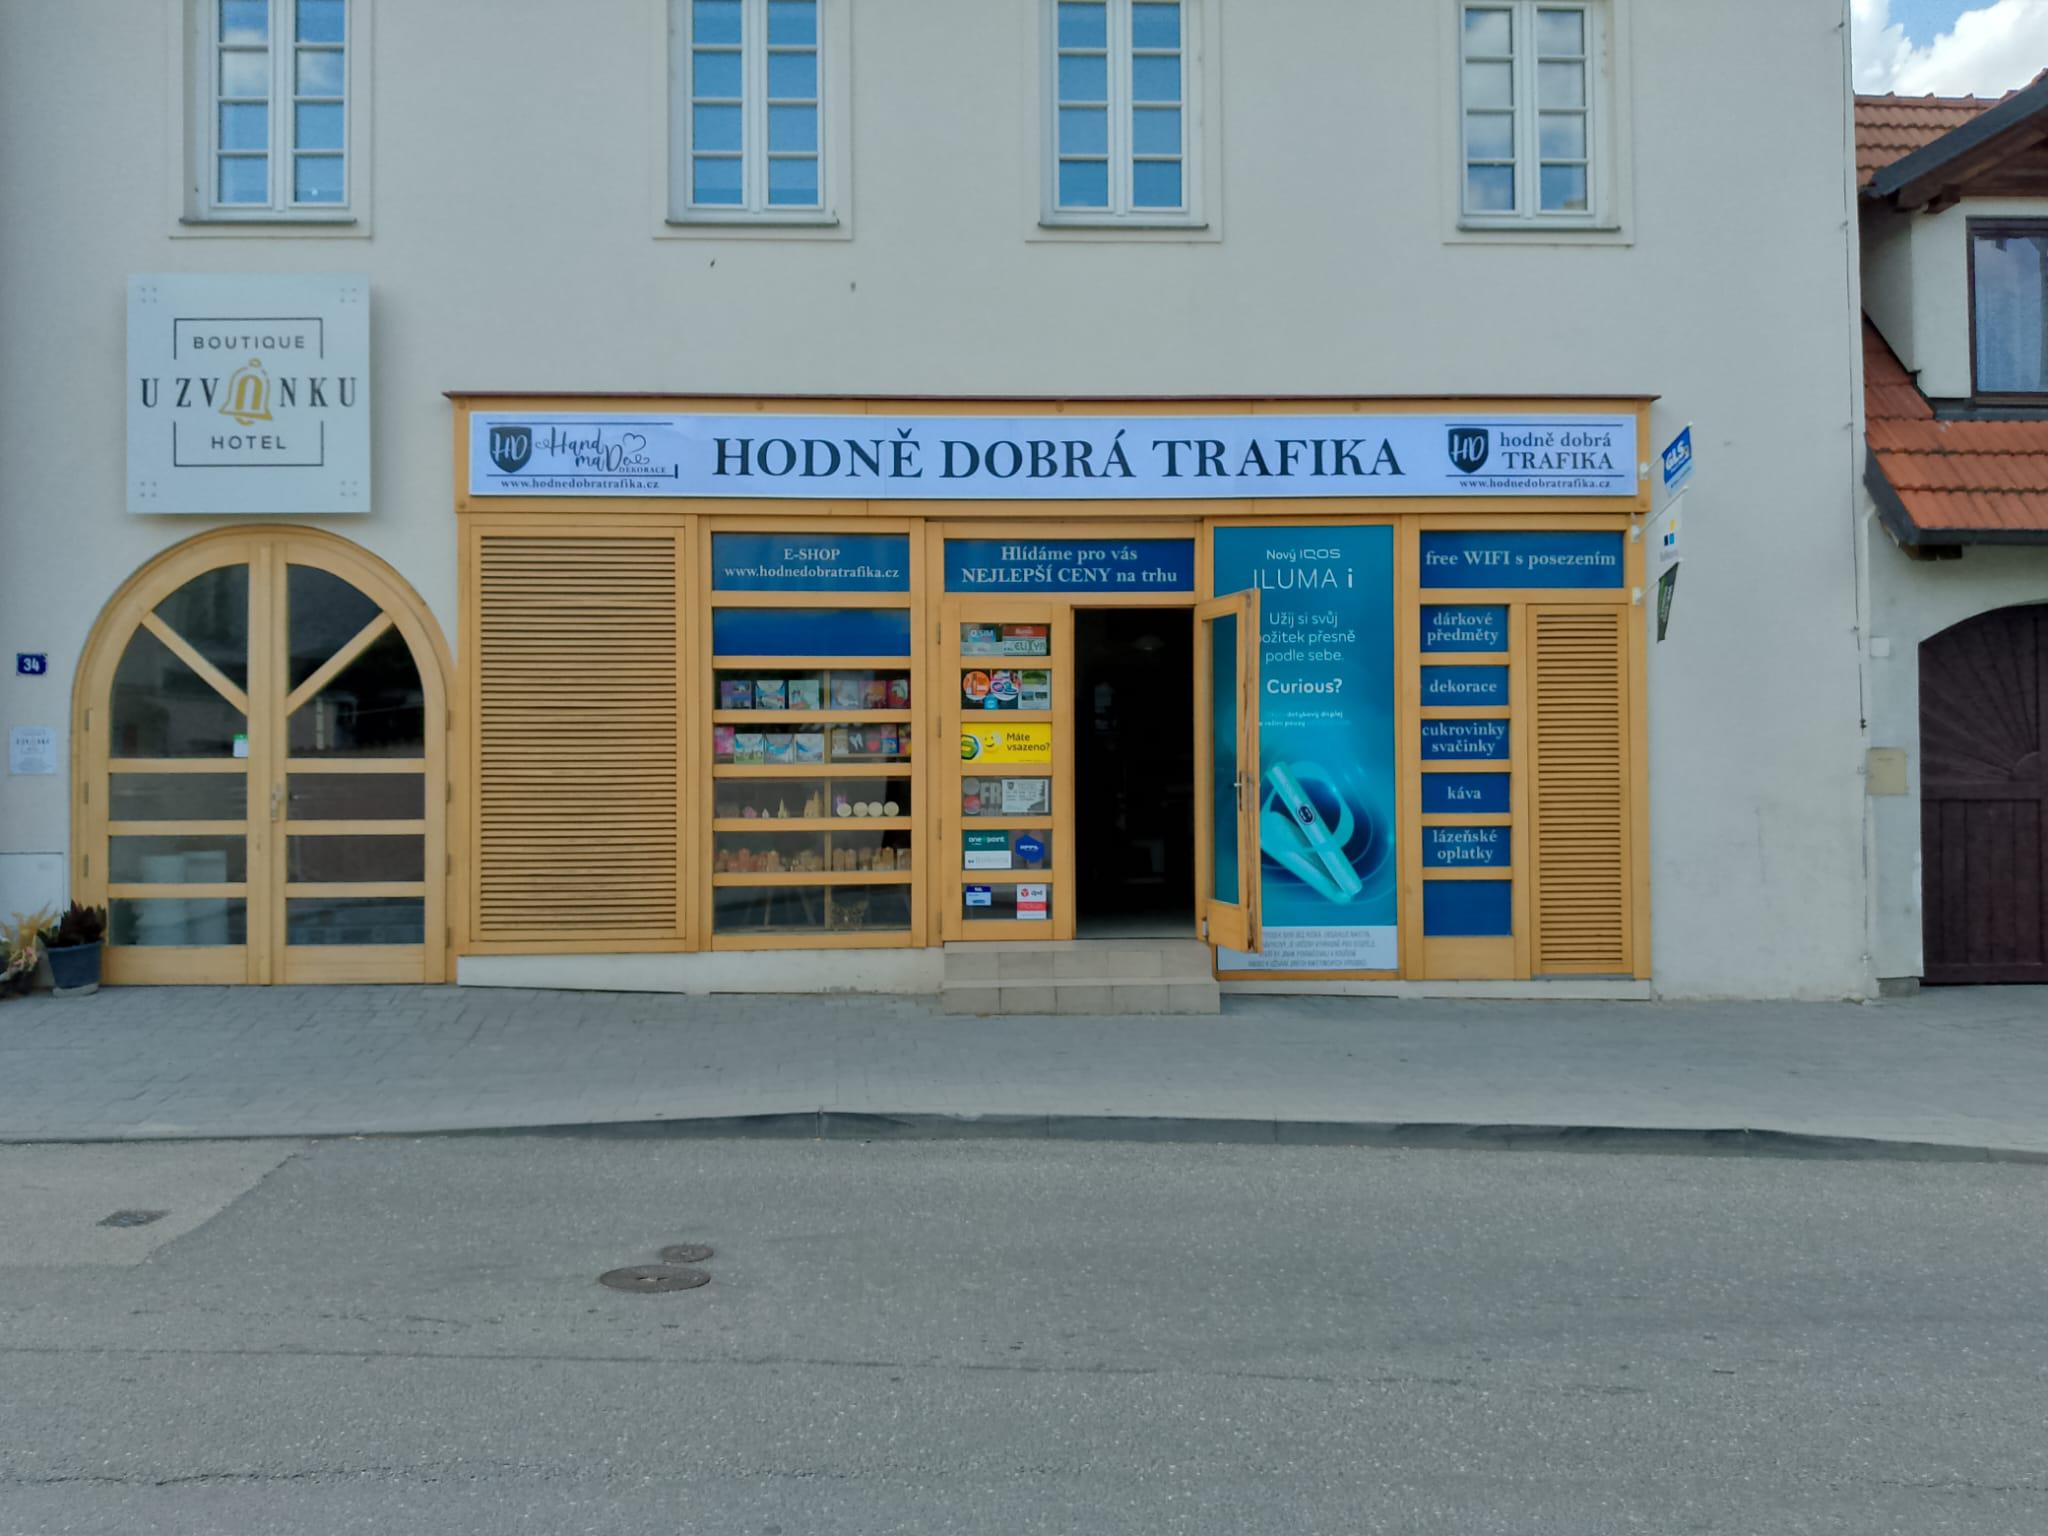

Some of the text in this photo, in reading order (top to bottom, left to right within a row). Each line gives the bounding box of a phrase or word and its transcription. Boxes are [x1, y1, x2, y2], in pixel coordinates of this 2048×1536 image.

[193, 336, 305, 350] BOUTIQUE
[211, 436, 287, 450] HOTEL
[535, 427, 605, 458] Hand
[1499, 432, 1612, 448] hodně dobrá
[712, 428, 1406, 478] HODNĚ DOBRÁ TRAFIKA
[1501, 452, 1614, 470] TRAFIKA
[500, 478, 660, 489] www.hodnedobratrafika.cz
[1460, 478, 1611, 489] www.hodnedobratrafika.cz
[784, 548, 841, 561] E-SHOP
[1001, 545, 1138, 565] Hlídáme pro vás
[1266, 549, 1341, 562] Nový IQOS
[1426, 550, 1616, 570] free WIFI s posezením
[724, 565, 900, 579] www.hodnedobratrafika.cz
[962, 565, 1178, 584] NEJLEPŠÍ CENY na trhu
[1253, 568, 1353, 589] ILUMA i
[1269, 611, 1338, 629] Užij si svůj
[1433, 613, 1493, 625] dárkové
[1308, 630, 1356, 645] přesně
[1427, 628, 1498, 645] předměty
[1265, 649, 1304, 664] podle
[23, 658, 40, 672] 34
[1266, 678, 1342, 694] Curious?
[1429, 680, 1497, 693] dekorace
[1006, 733, 1030, 741] Máte
[1422, 723, 1505, 740] cukrovinky
[1006, 743, 1050, 751] vsazeno?
[1432, 740, 1495, 756] svačinky
[1447, 786, 1481, 799] káva
[1433, 829, 1498, 843] lázeňské
[1437, 846, 1494, 862] oplatky
